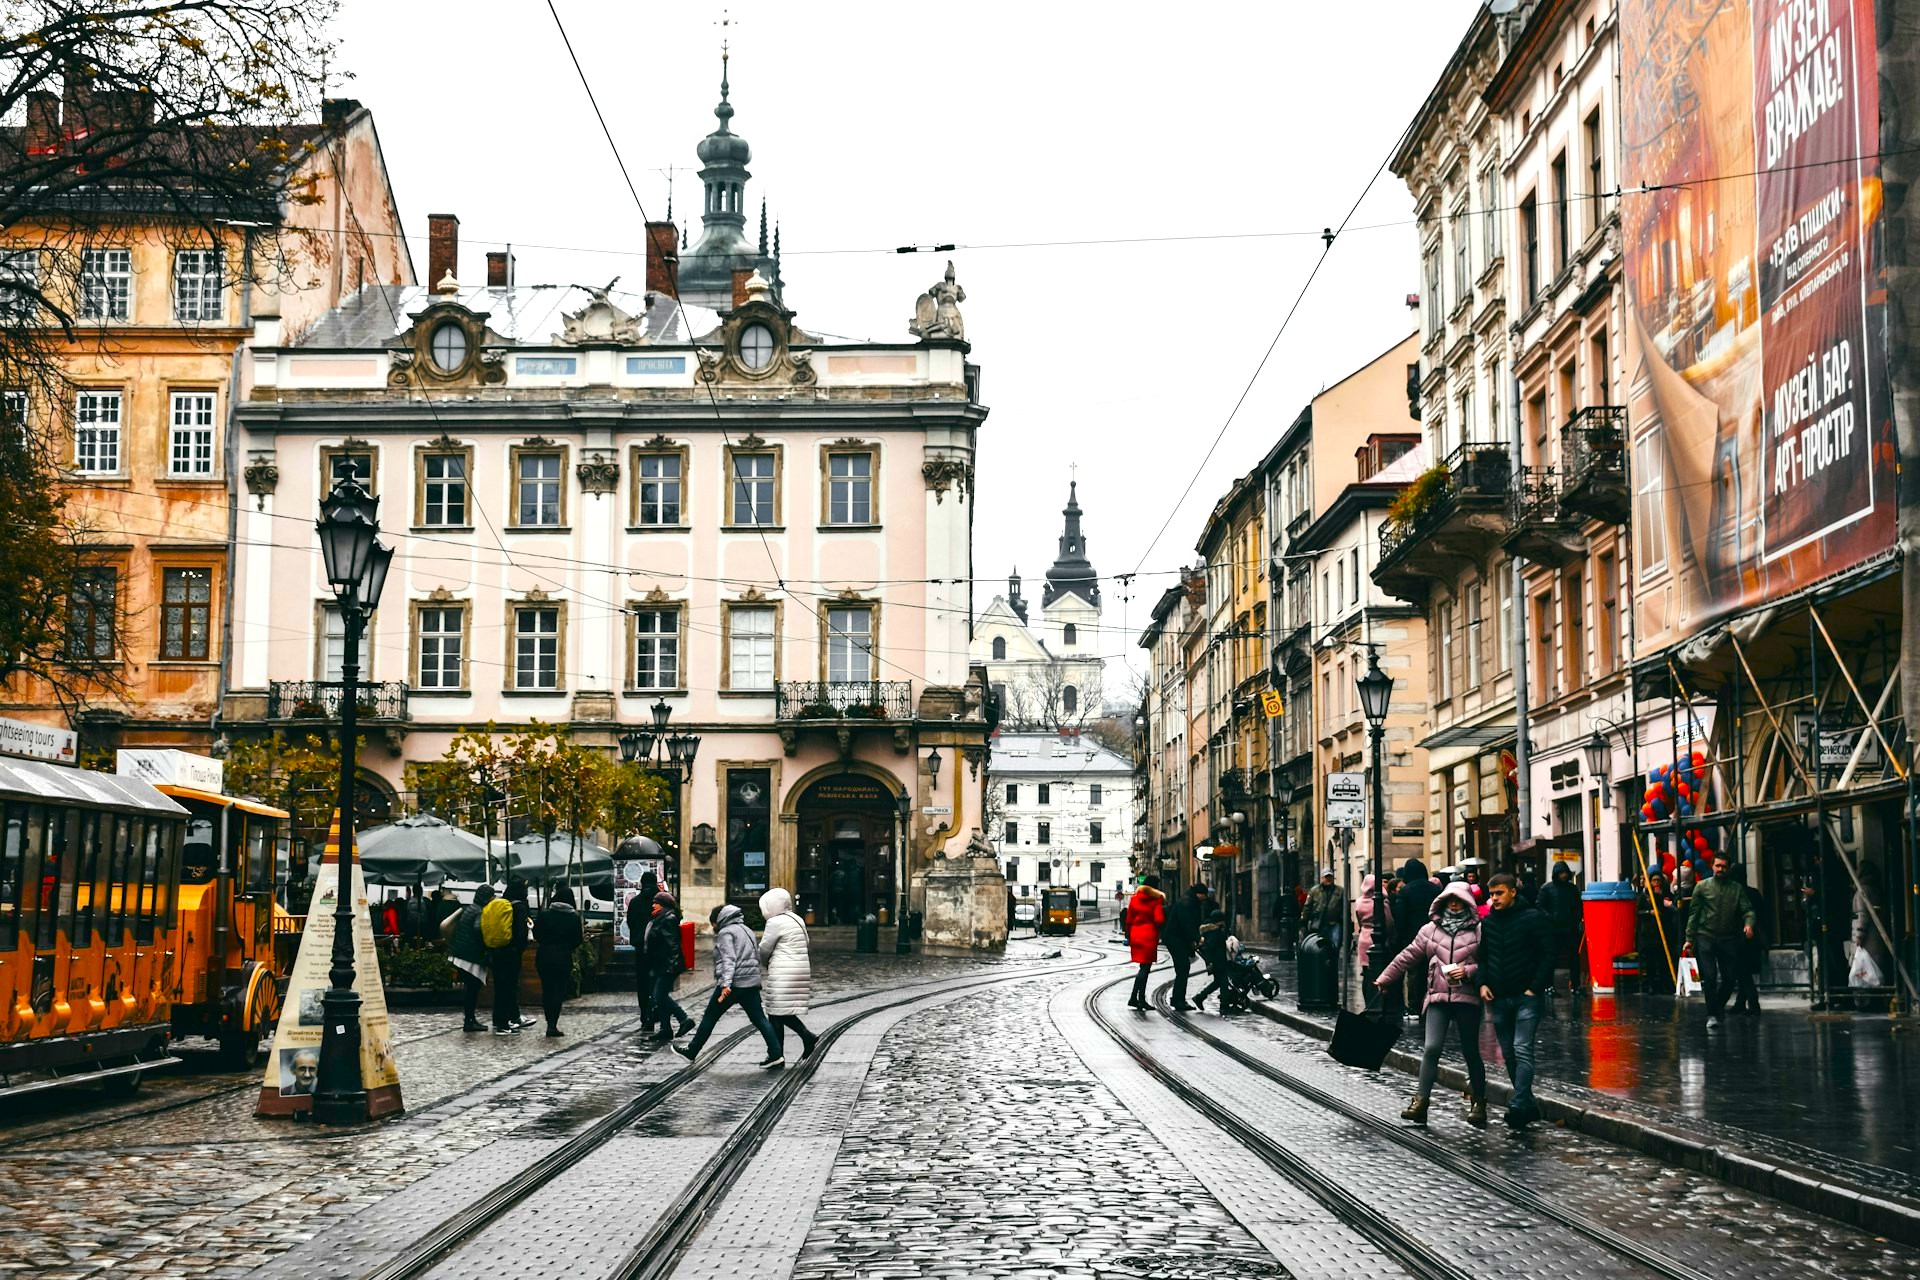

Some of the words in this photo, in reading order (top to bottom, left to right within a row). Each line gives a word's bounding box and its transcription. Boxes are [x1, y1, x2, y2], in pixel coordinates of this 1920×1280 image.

[1765, 28, 1843, 169] ВРАЖАЄ!
[1786, 260, 1798, 280] ВІД
[1797, 235, 1829, 271] ОПЕРНОГО
[638, 360, 674, 371] ПРОСВІТА
[1774, 351, 1822, 438] МУЗЕЙ.
[1822, 339, 1853, 403] БАР.
[1774, 401, 1855, 496] АРТ-ПРОСТІР
[1269, 703, 1278, 711] 15
[35, 729, 55, 747] tours
